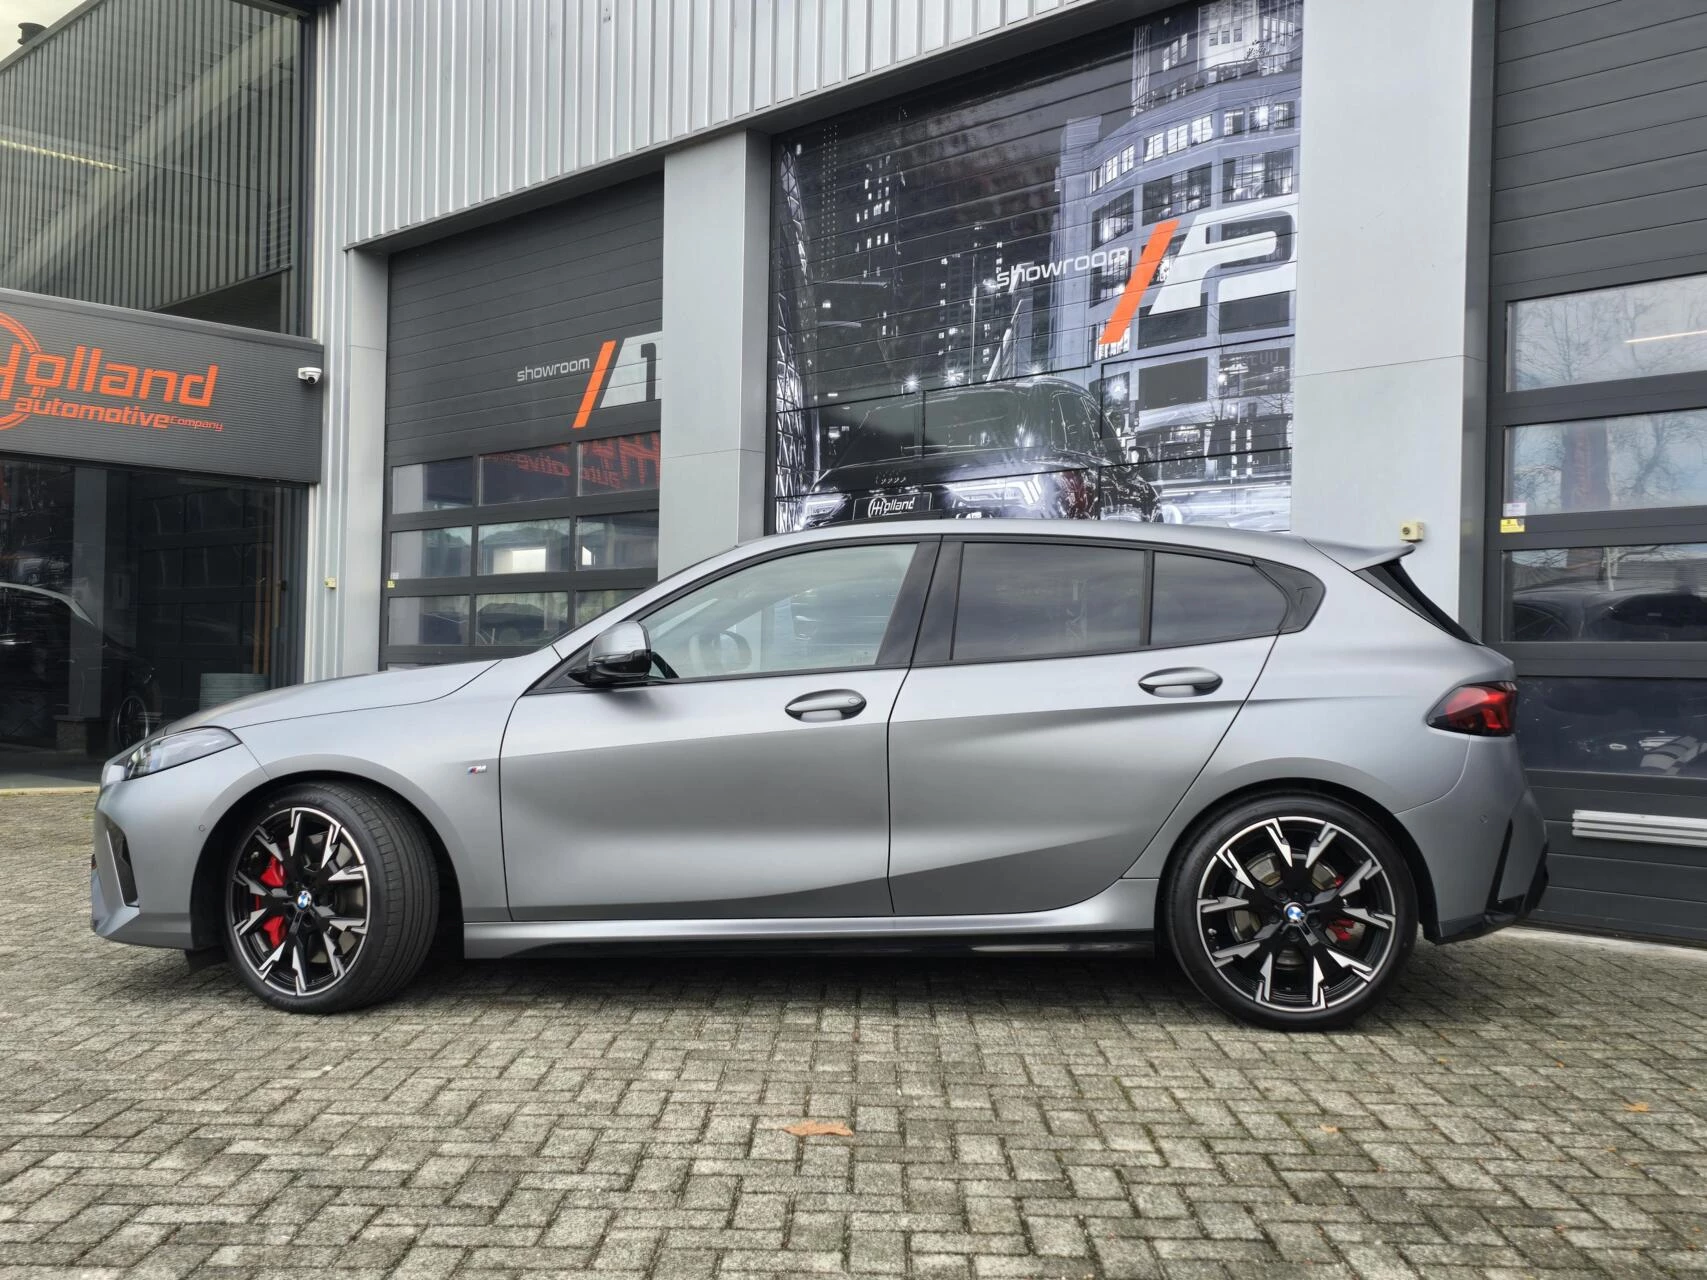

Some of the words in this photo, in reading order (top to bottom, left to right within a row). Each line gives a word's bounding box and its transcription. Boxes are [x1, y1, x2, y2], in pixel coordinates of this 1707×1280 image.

[996, 246, 1130, 289] showroom
[516, 357, 591, 382] showroom
[14, 396, 170, 429] automotive
